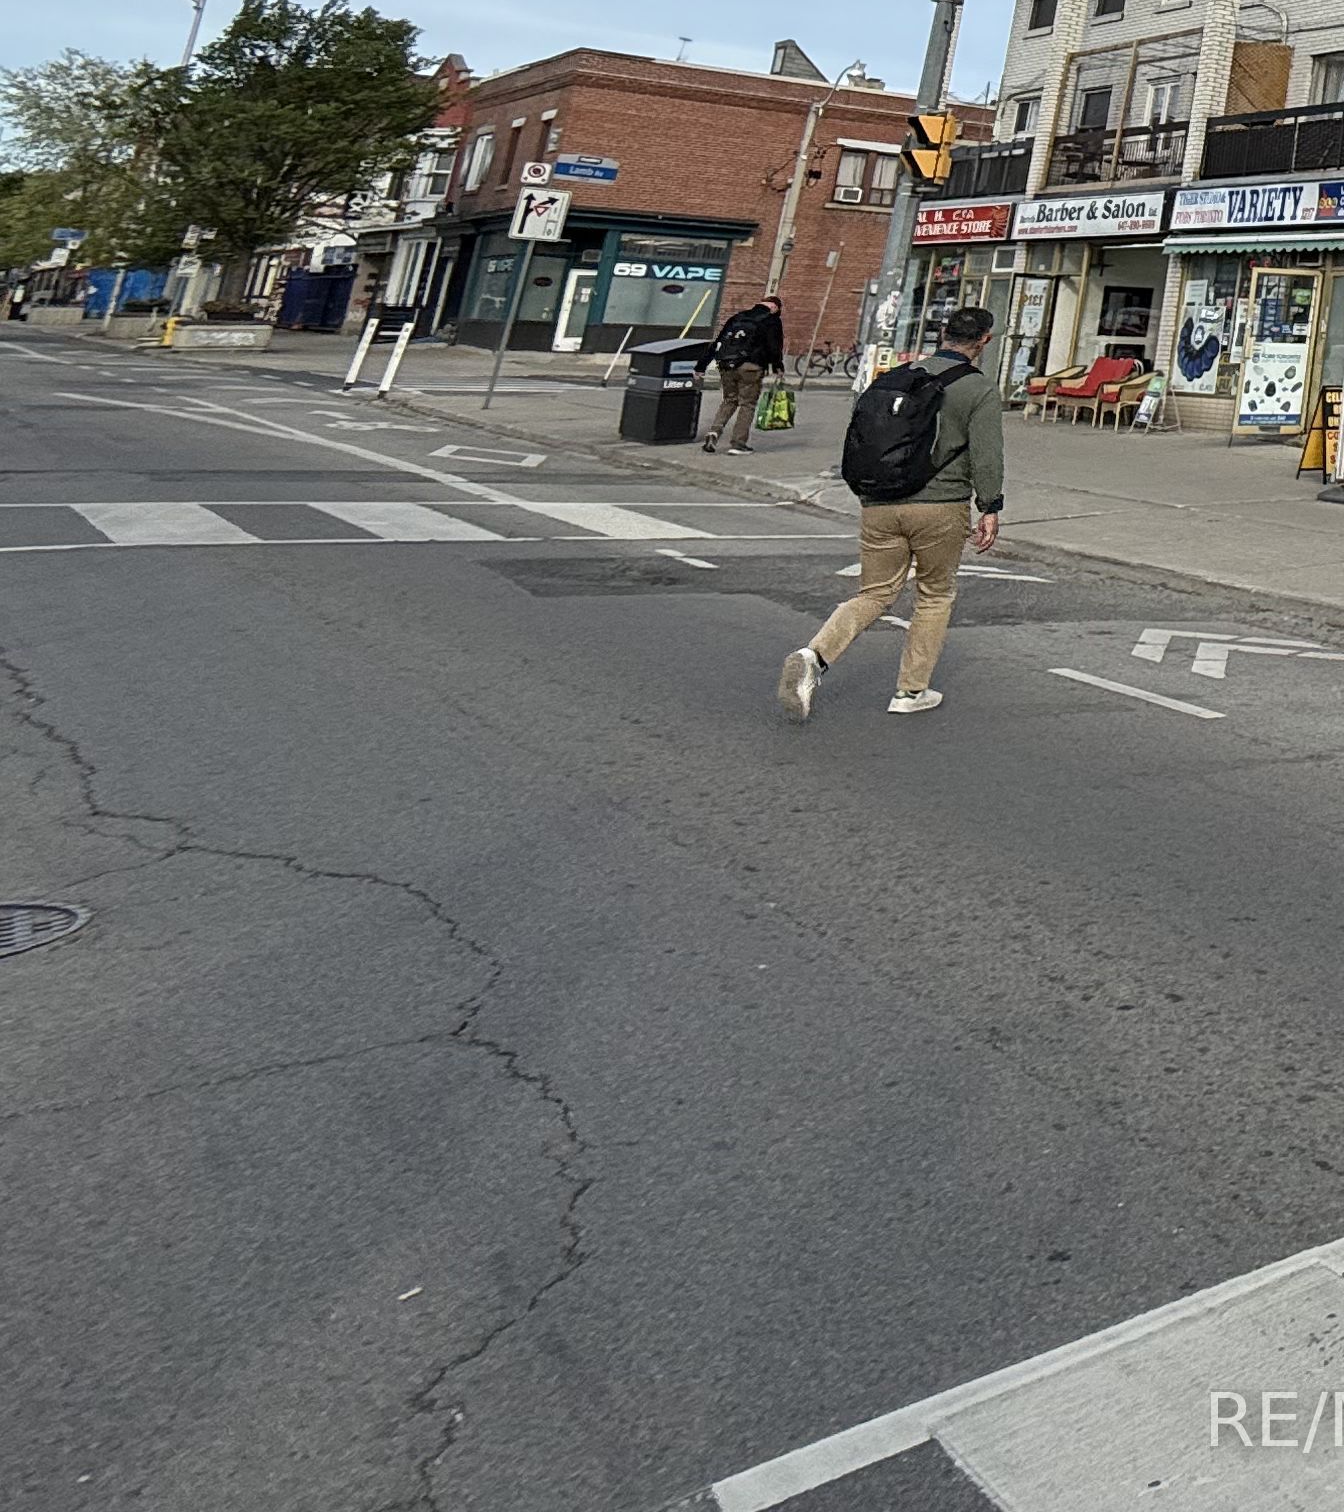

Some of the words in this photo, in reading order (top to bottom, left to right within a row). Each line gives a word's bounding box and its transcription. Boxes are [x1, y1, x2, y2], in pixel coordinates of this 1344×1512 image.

[1036, 201, 1085, 223] Barber
[1086, 201, 1099, 221] &
[1101, 199, 1145, 219] Salon
[1227, 186, 1304, 224] VARIETY
[914, 222, 960, 237] NVENIENCE
[961, 220, 992, 234] STORE
[613, 262, 647, 277] 69
[652, 265, 723, 280] VAPE
